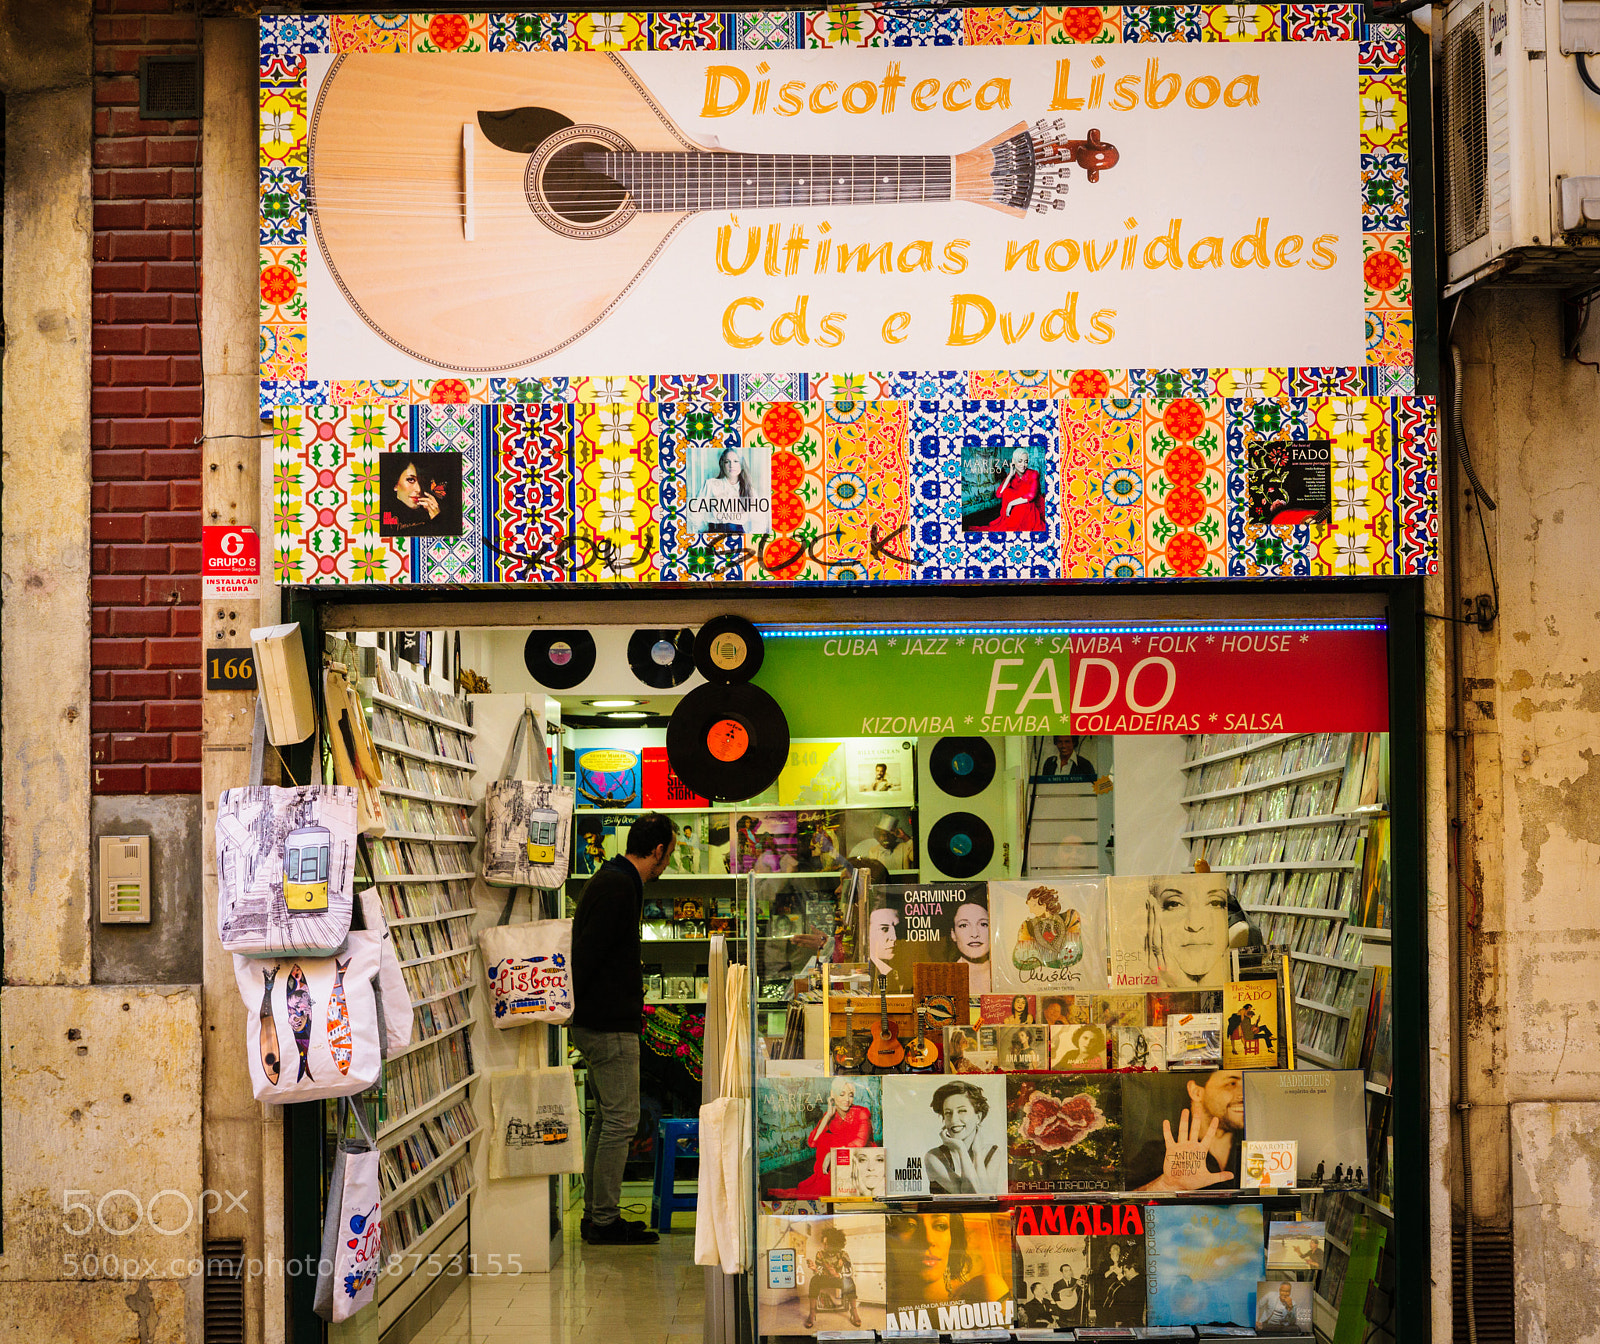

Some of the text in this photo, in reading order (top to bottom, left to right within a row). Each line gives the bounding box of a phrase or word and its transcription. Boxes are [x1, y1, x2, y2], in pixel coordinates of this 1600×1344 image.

[699, 55, 1261, 118] Discoteca Lisboa
[1003, 216, 1340, 273] novidades
[722, 291, 1118, 349] Cds e Dvds
[1292, 449, 1329, 460] FADO
[963, 459, 1010, 468] MARIZA
[688, 497, 770, 513] CARMINHO
[716, 513, 742, 521] CANTO
[208, 557, 257, 567] GRUPO 8
[823, 635, 1292, 657] CUBA JAZZ ROCK SAMBA FOLK HOUSE
[210, 657, 252, 680] 166
[984, 656, 1177, 715] FADO
[861, 713, 1285, 735] KIZOMBA SEMBA COLADEIRAS SALSA
[785, 751, 818, 767] B40
[904, 889, 967, 903] CARMINHO
[904, 903, 943, 916] CANTA
[904, 916, 931, 929] TOM
[905, 929, 941, 942] JOBIM
[1115, 950, 1142, 962] Best
[1116, 963, 1130, 974] of
[495, 966, 566, 997] Lisboa
[1116, 973, 1158, 986] Mariza
[1237, 990, 1272, 1002] FADO
[1279, 1073, 1331, 1088] MADREDEUS
[763, 1093, 823, 1104] MARIZA
[1249, 1142, 1294, 1151] PAVAROTTI
[906, 1157, 922, 1169] ANA
[1268, 1151, 1293, 1171] 50
[894, 1169, 922, 1181] MOURA
[889, 1181, 922, 1192] DESFADO
[1146, 1208, 1161, 1257] paredes
[1147, 1260, 1158, 1295] carlos
[886, 1300, 1014, 1330] ANA MOURA
